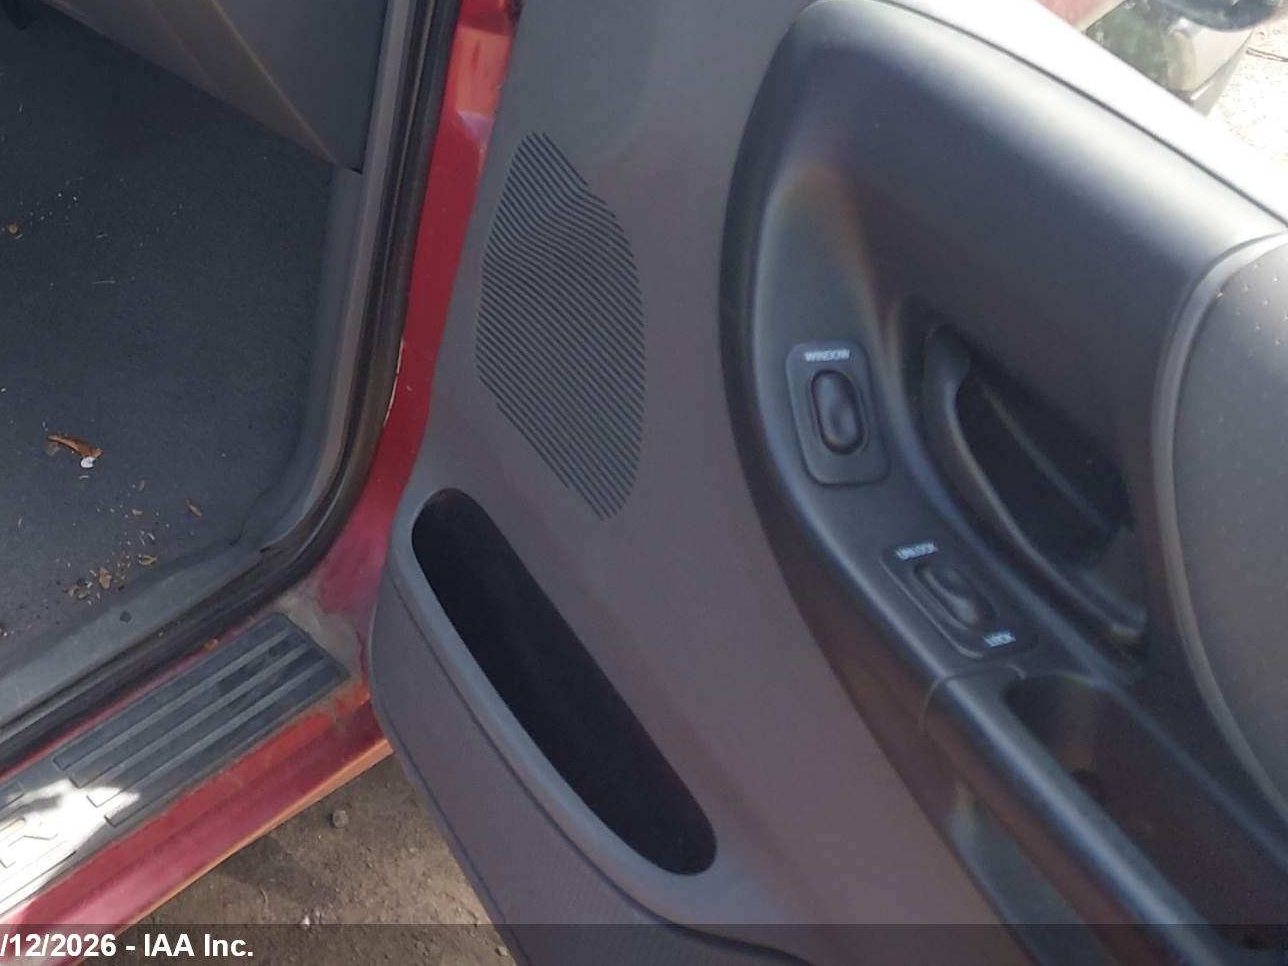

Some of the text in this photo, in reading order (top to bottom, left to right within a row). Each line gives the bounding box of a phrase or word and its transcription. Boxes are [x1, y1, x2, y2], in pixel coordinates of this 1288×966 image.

[804, 348, 851, 363] WINDOW
[895, 541, 938, 561] UNLOCK
[984, 630, 1017, 648] LOCK
